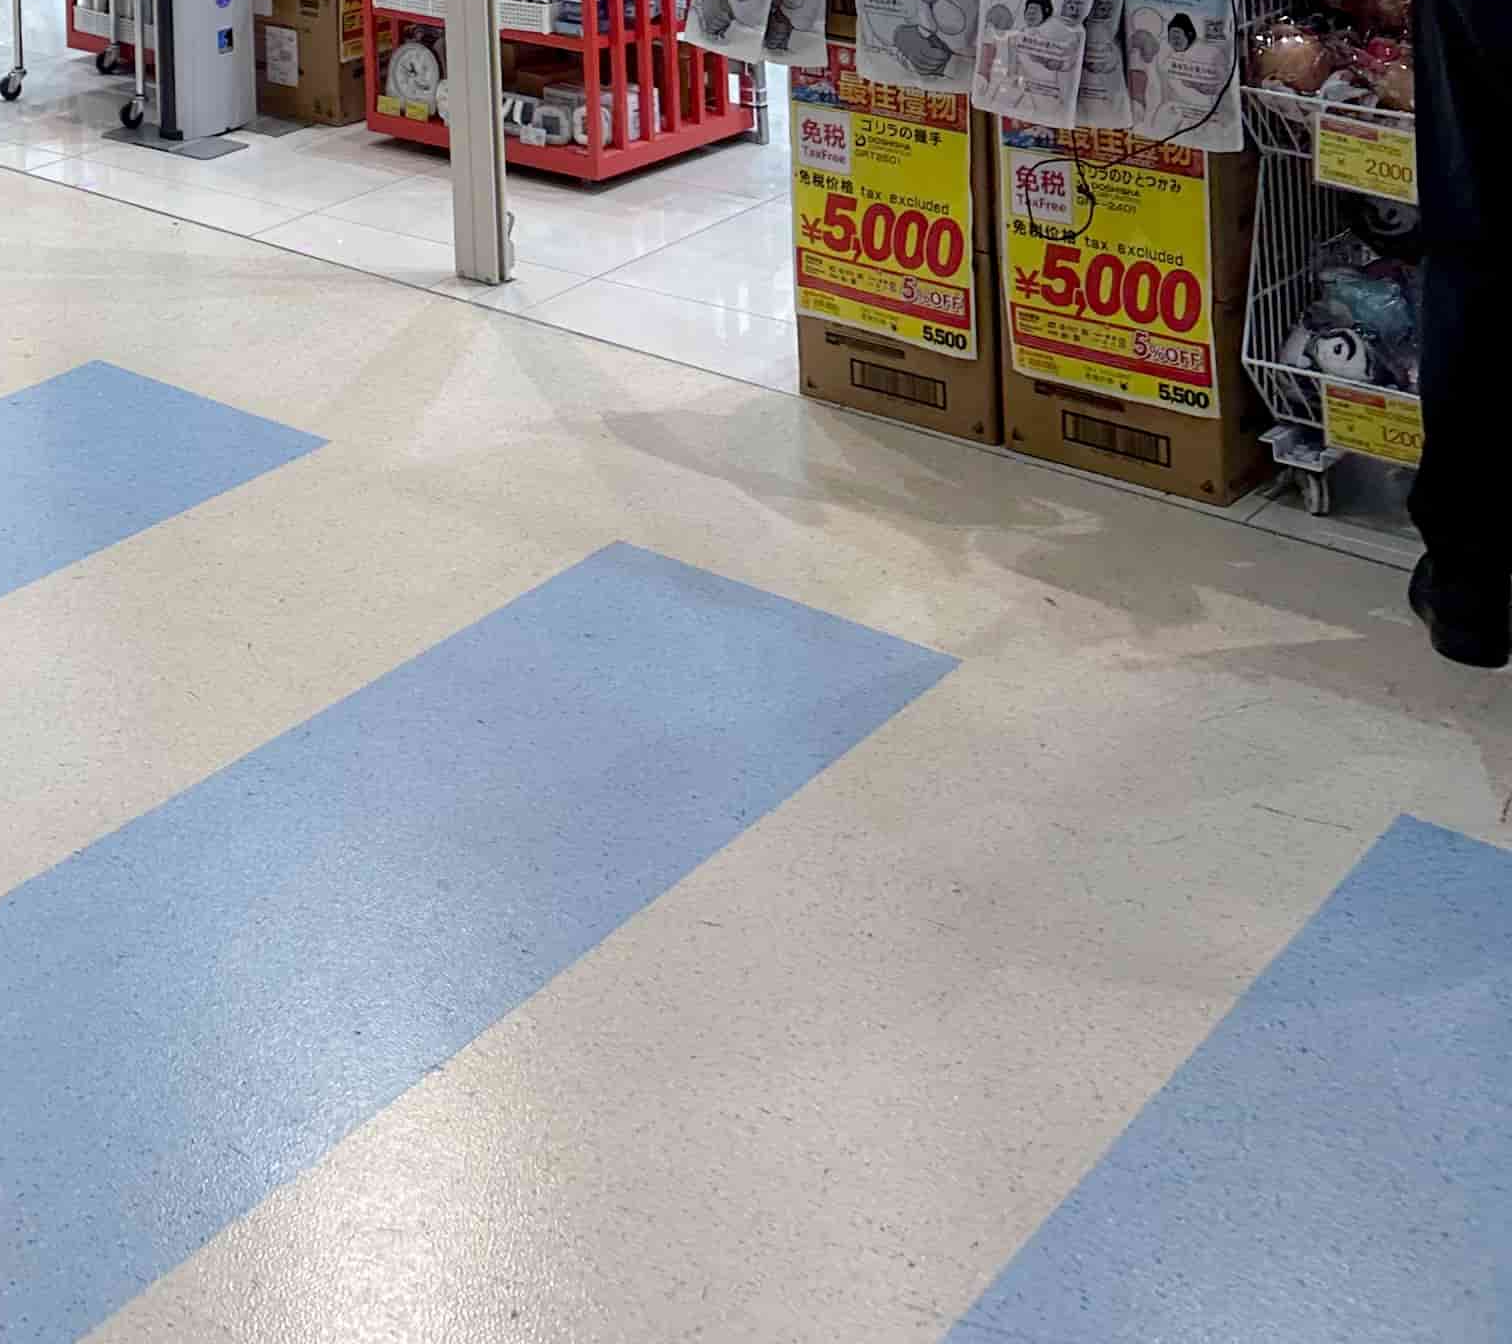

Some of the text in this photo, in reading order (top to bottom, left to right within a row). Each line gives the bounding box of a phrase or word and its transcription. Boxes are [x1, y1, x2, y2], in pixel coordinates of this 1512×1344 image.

[801, 116, 847, 150] 免税
[860, 118, 943, 146] ゴリラの握手
[799, 169, 950, 216] 免税价格 tax excluded
[1015, 165, 1066, 197] 免税
[800, 191, 965, 278] ¥5,000
[1085, 235, 1108, 251] tax
[1117, 242, 1185, 267] excluded
[1014, 242, 1203, 333] ¥5,000
[922, 324, 968, 350] 5,500
[1158, 382, 1210, 410] 5,500
